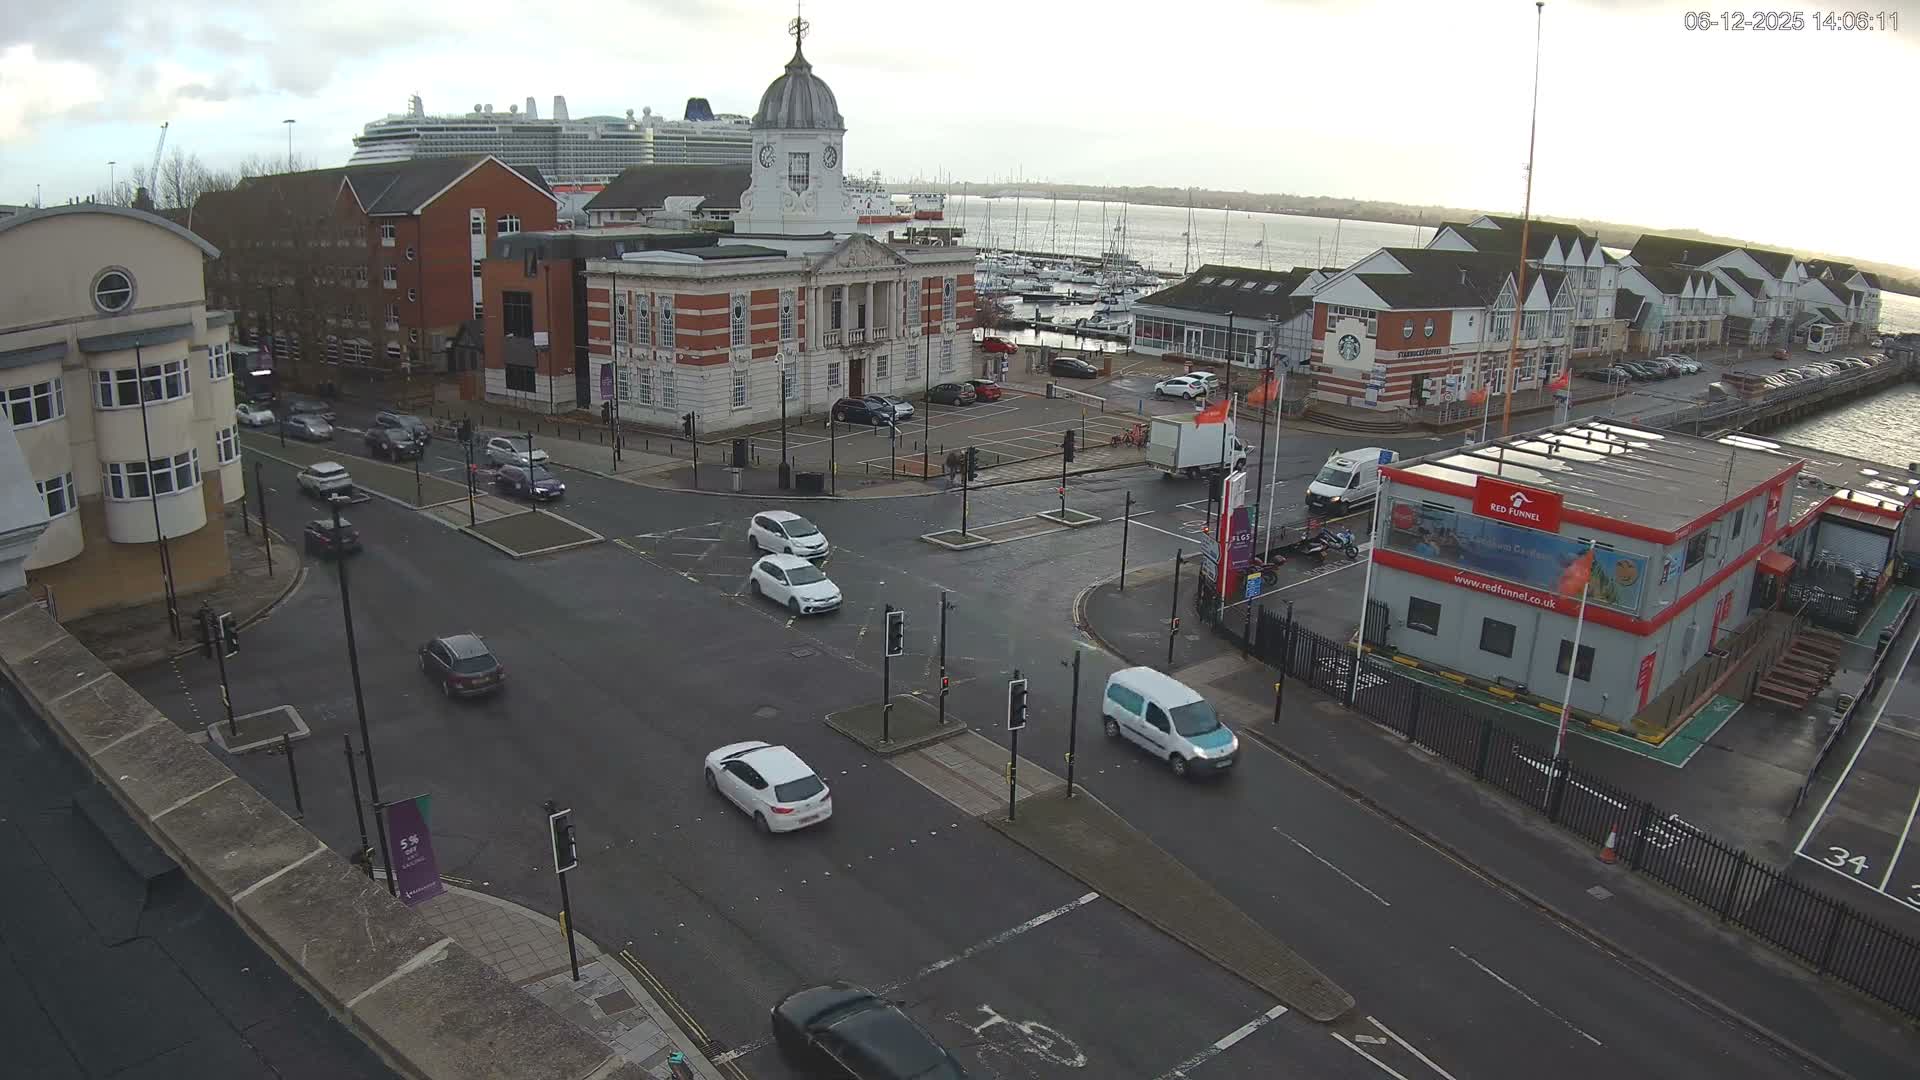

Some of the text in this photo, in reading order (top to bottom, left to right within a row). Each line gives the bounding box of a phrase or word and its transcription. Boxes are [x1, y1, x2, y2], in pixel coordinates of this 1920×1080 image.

[1397, 348, 1442, 359] STARBUCKS COFFEE
[1490, 503, 1541, 522] RED FUNNEL
[1454, 574, 1556, 609] www.redfunnel.co.uk
[1823, 846, 1870, 875] 34
